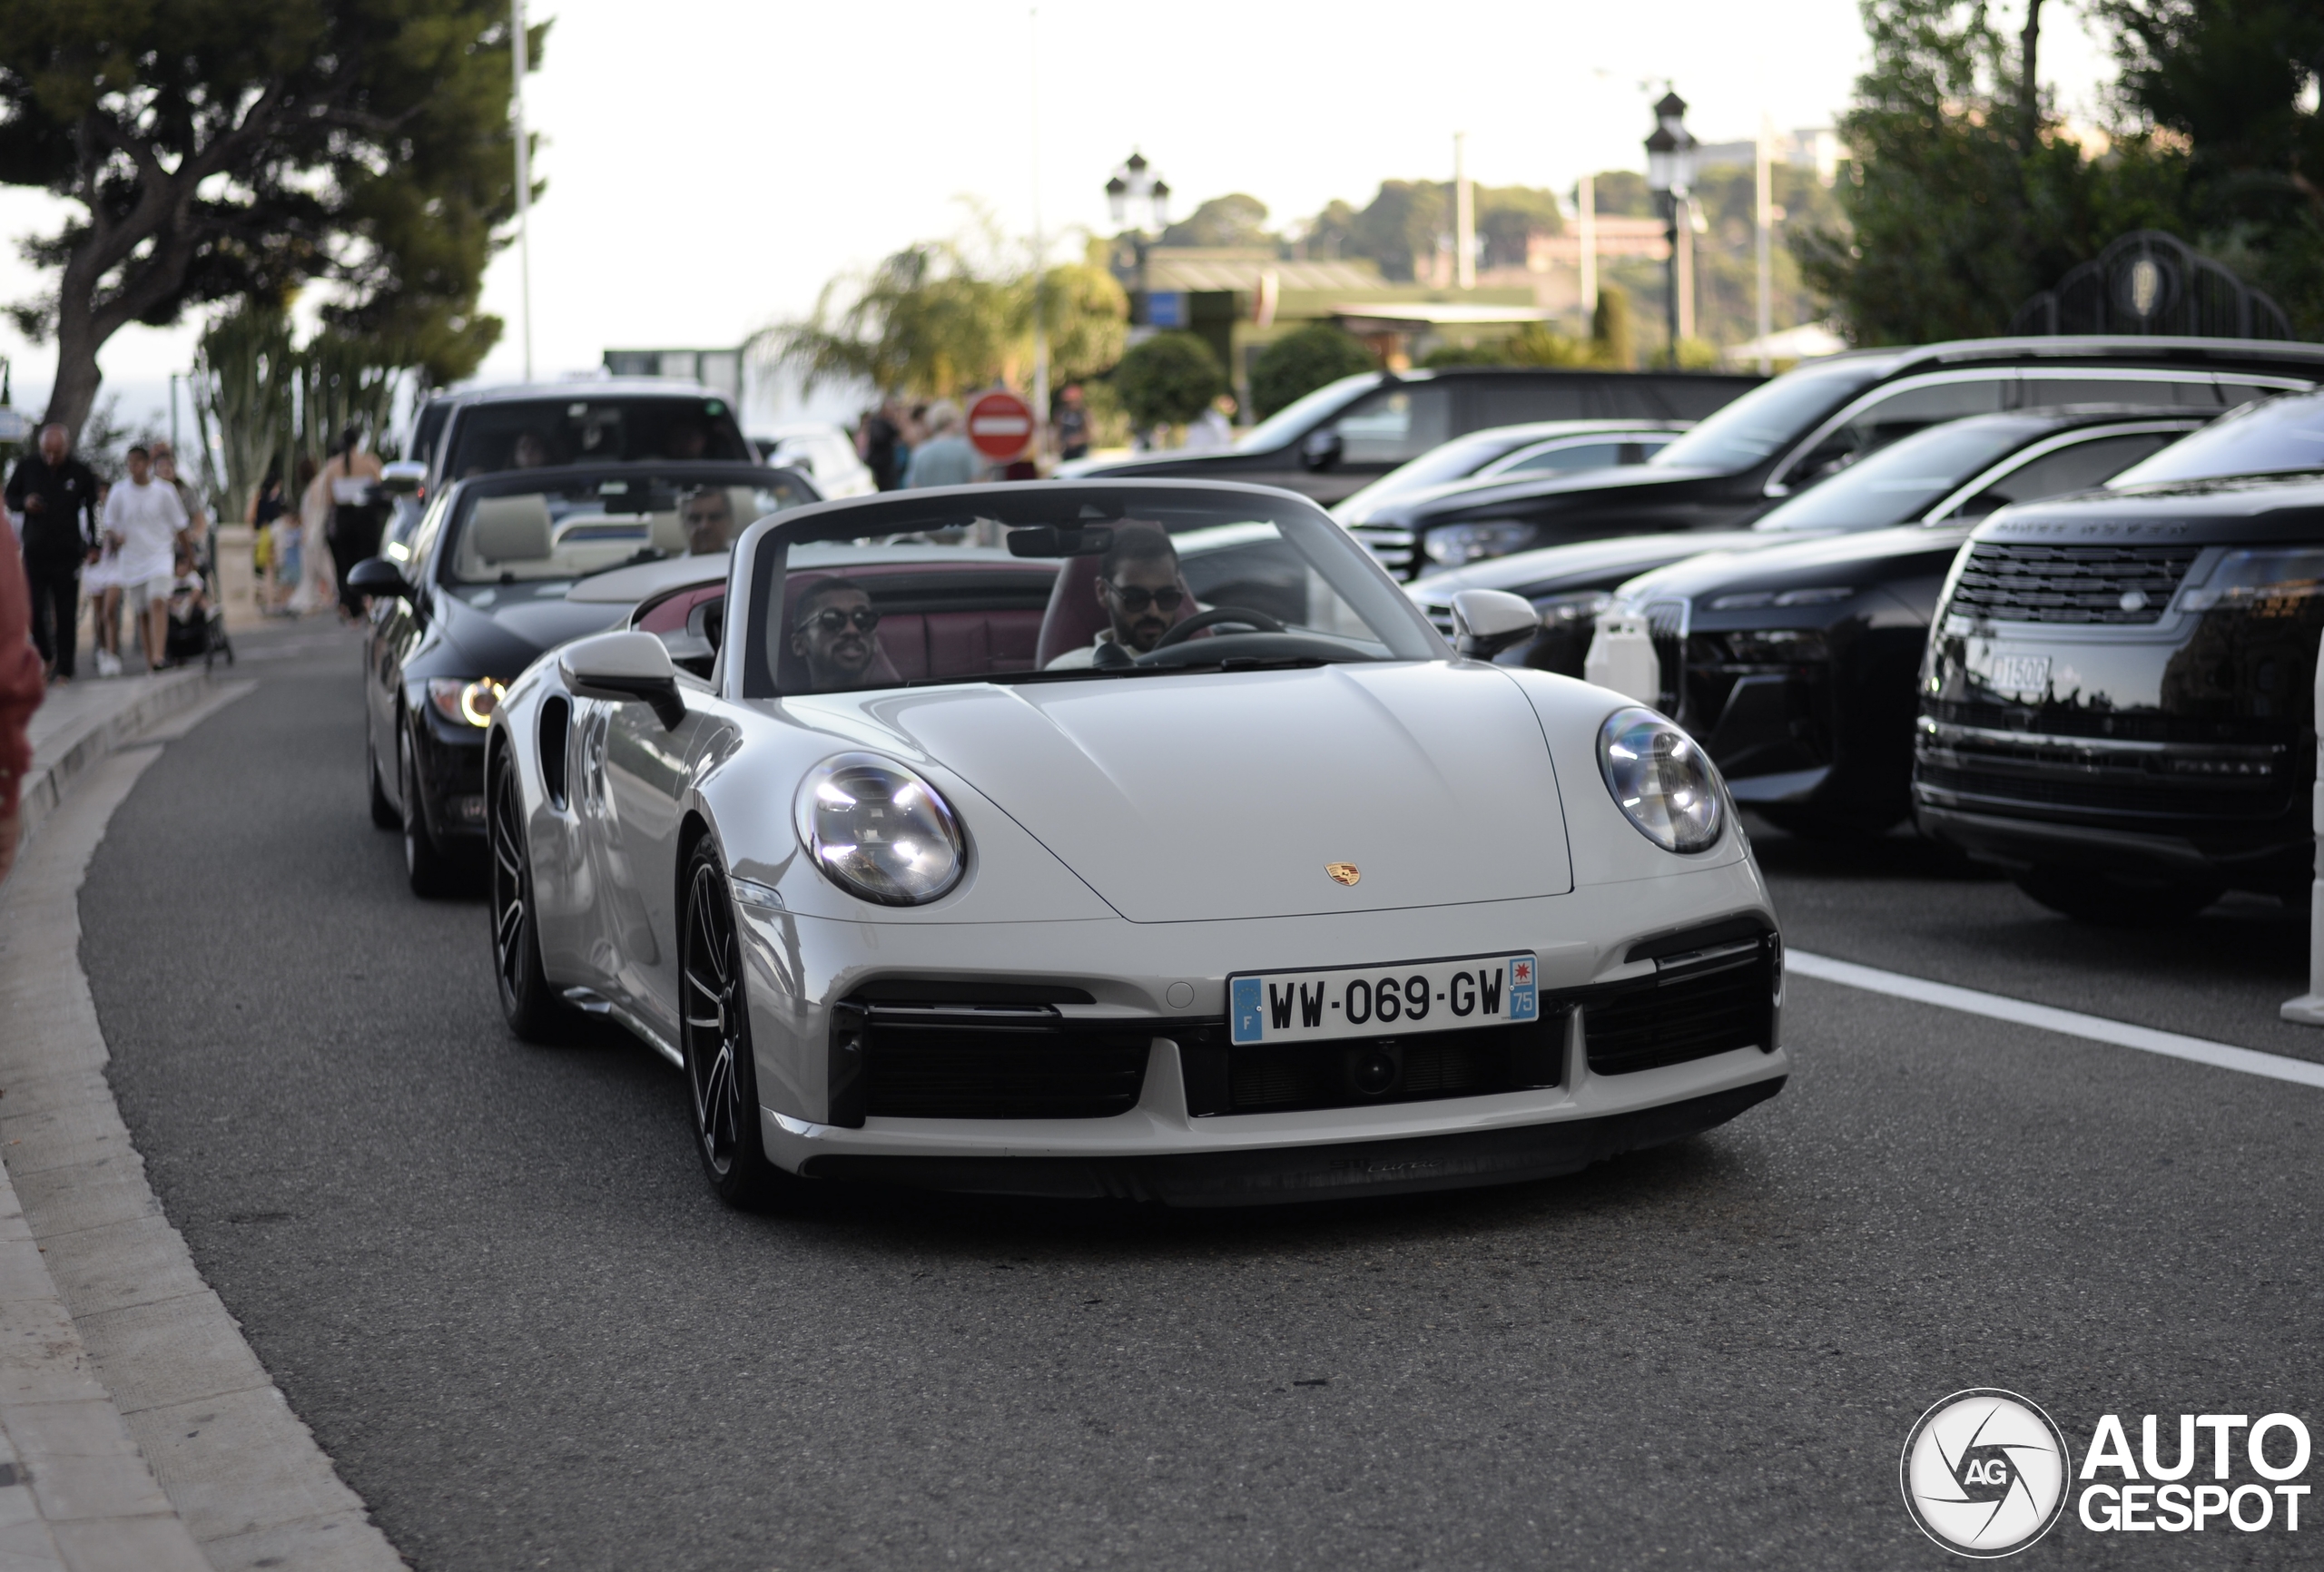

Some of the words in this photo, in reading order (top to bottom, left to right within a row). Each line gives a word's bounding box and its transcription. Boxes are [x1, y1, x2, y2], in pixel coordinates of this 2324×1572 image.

[1268, 968, 1503, 1029] WW-069-GW
[1513, 991, 1532, 1013] 75
[1244, 1016, 1253, 1031] F
